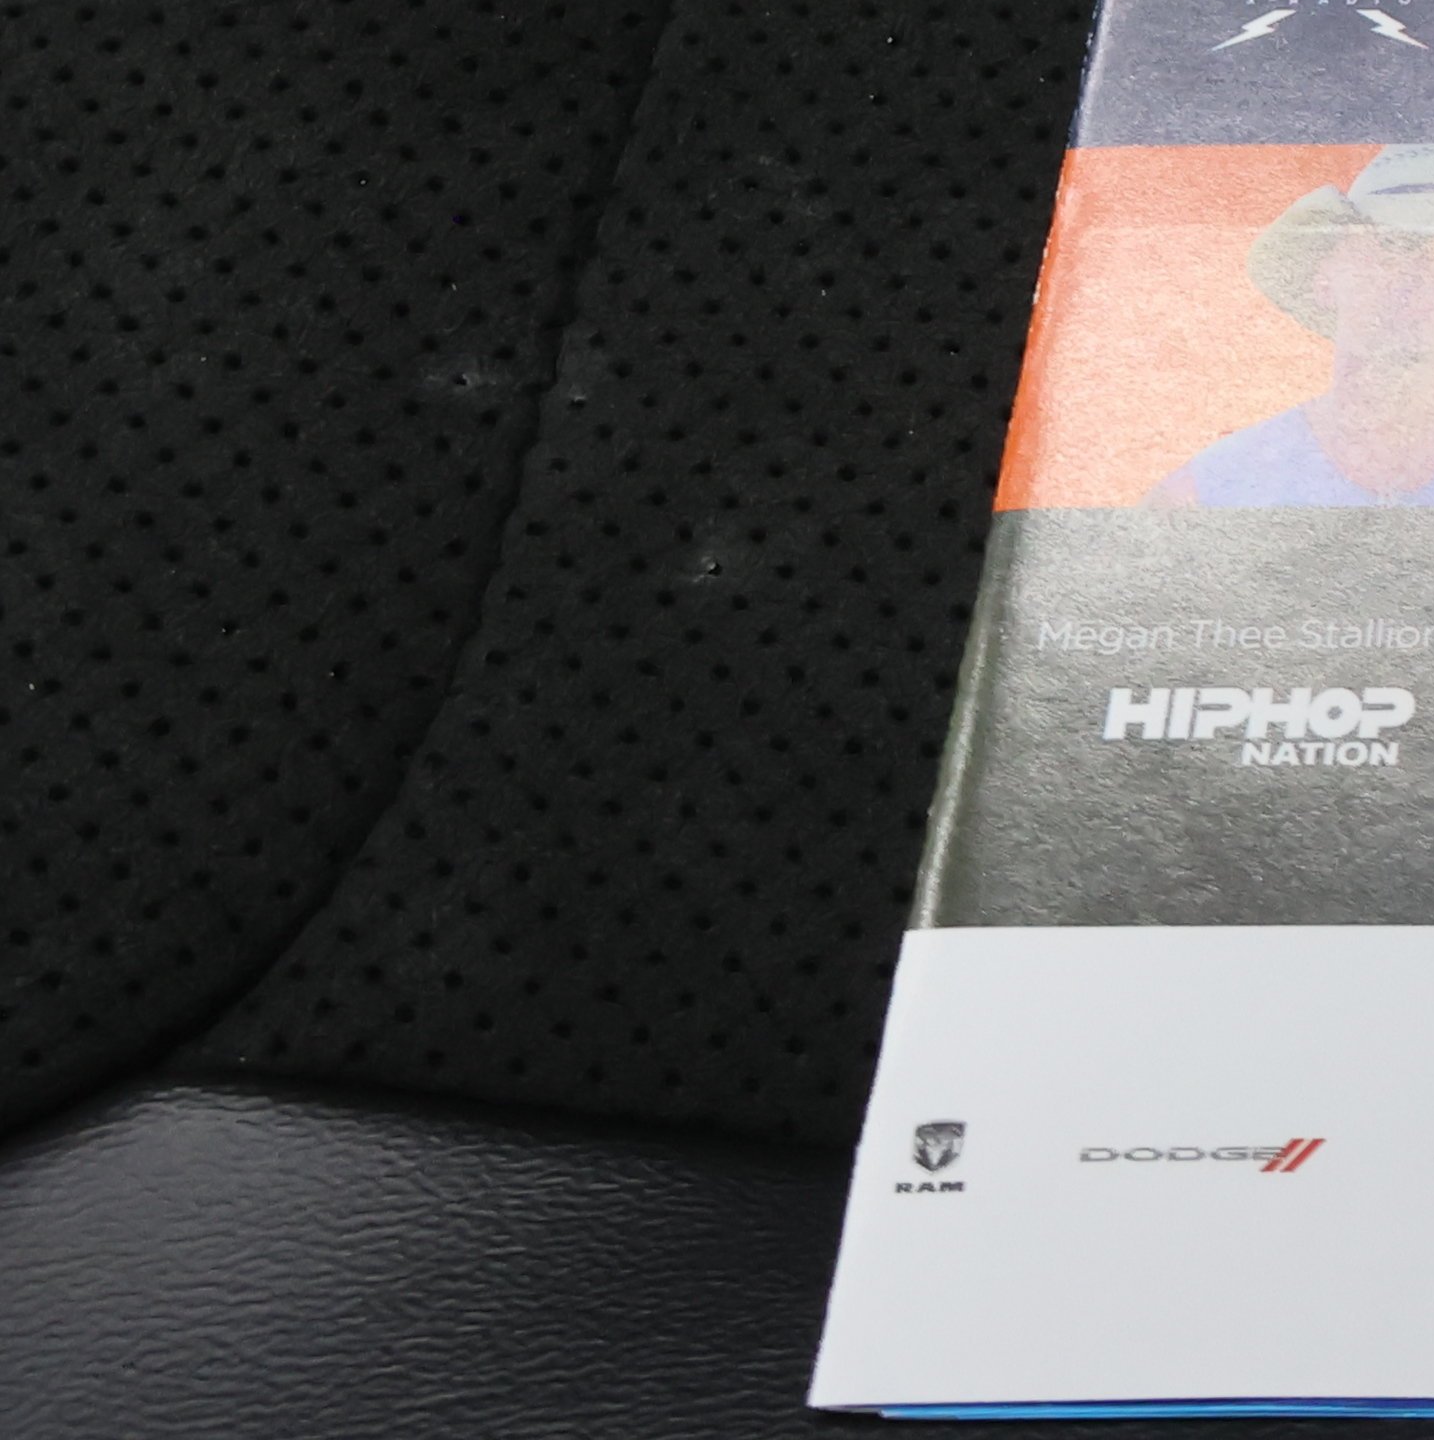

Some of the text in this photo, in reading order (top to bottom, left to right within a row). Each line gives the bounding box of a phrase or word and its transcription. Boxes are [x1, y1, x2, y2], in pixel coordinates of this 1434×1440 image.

[1037, 618, 1175, 655] Megan
[1190, 620, 1287, 648] Thee
[1241, 741, 1399, 767] NATION
[895, 1182, 965, 1194] RAM
